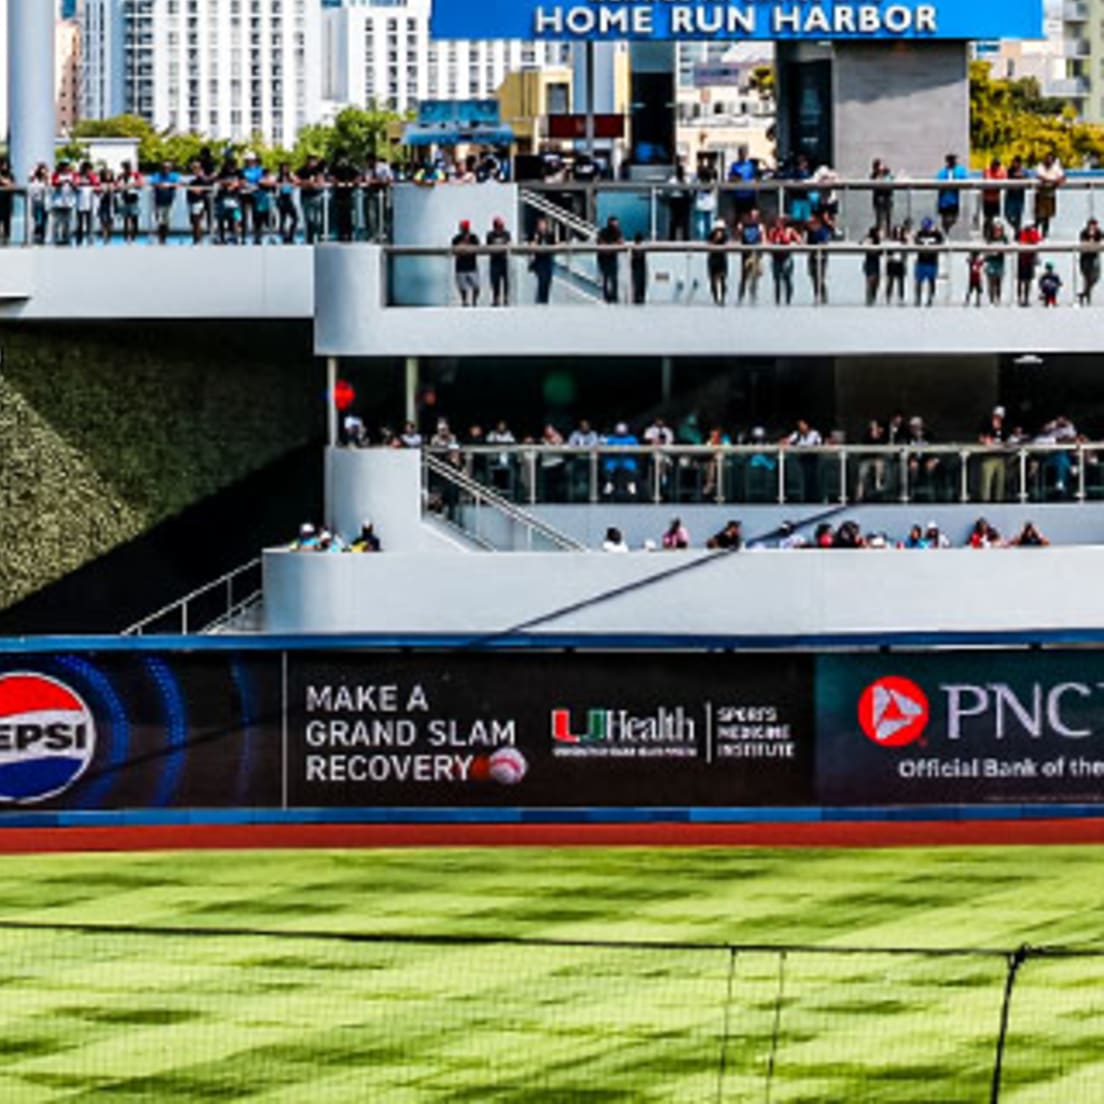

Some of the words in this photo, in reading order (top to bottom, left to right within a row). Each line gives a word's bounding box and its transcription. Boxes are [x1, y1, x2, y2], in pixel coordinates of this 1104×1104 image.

[535, 6, 653, 33] HOME
[671, 5, 755, 33] RUN
[774, 5, 938, 33] HARBOR
[306, 685, 398, 712] MAKE
[406, 684, 429, 712] A
[940, 682, 1092, 739] PNC
[305, 720, 416, 746] GRAND
[428, 720, 516, 746] SLAM
[716, 742, 794, 757] INSTITUTE
[306, 754, 474, 781] RECOVERY
[899, 758, 978, 778] Official
[983, 758, 1037, 777] Bank
[1041, 757, 1064, 777] of
